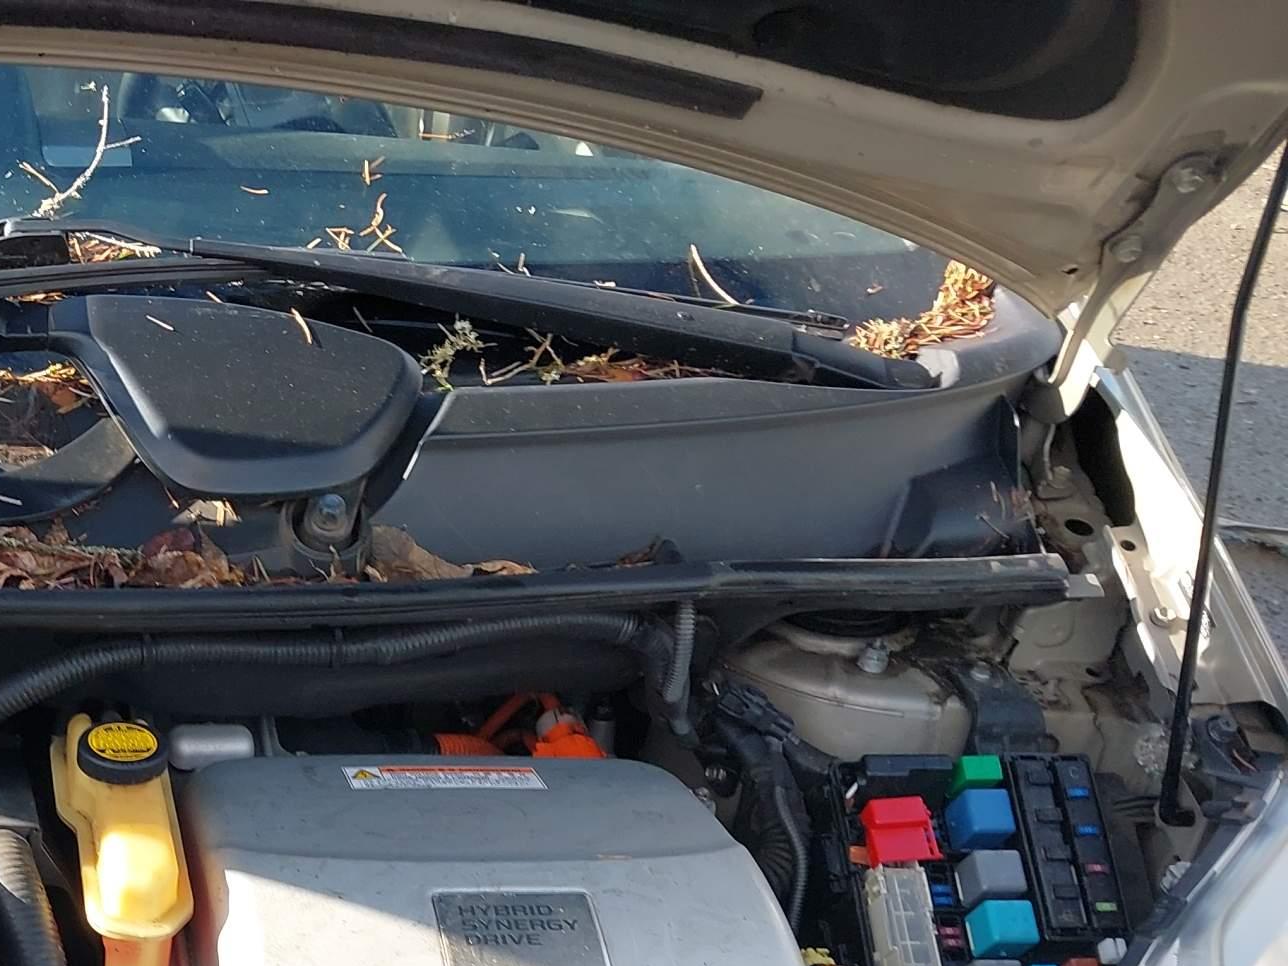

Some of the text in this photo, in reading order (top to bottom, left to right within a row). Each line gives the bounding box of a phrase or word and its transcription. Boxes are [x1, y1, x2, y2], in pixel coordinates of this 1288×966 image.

[457, 904, 553, 917] HYBRID
[461, 918, 578, 932] SYNERGY
[465, 933, 544, 946] DRIVE
